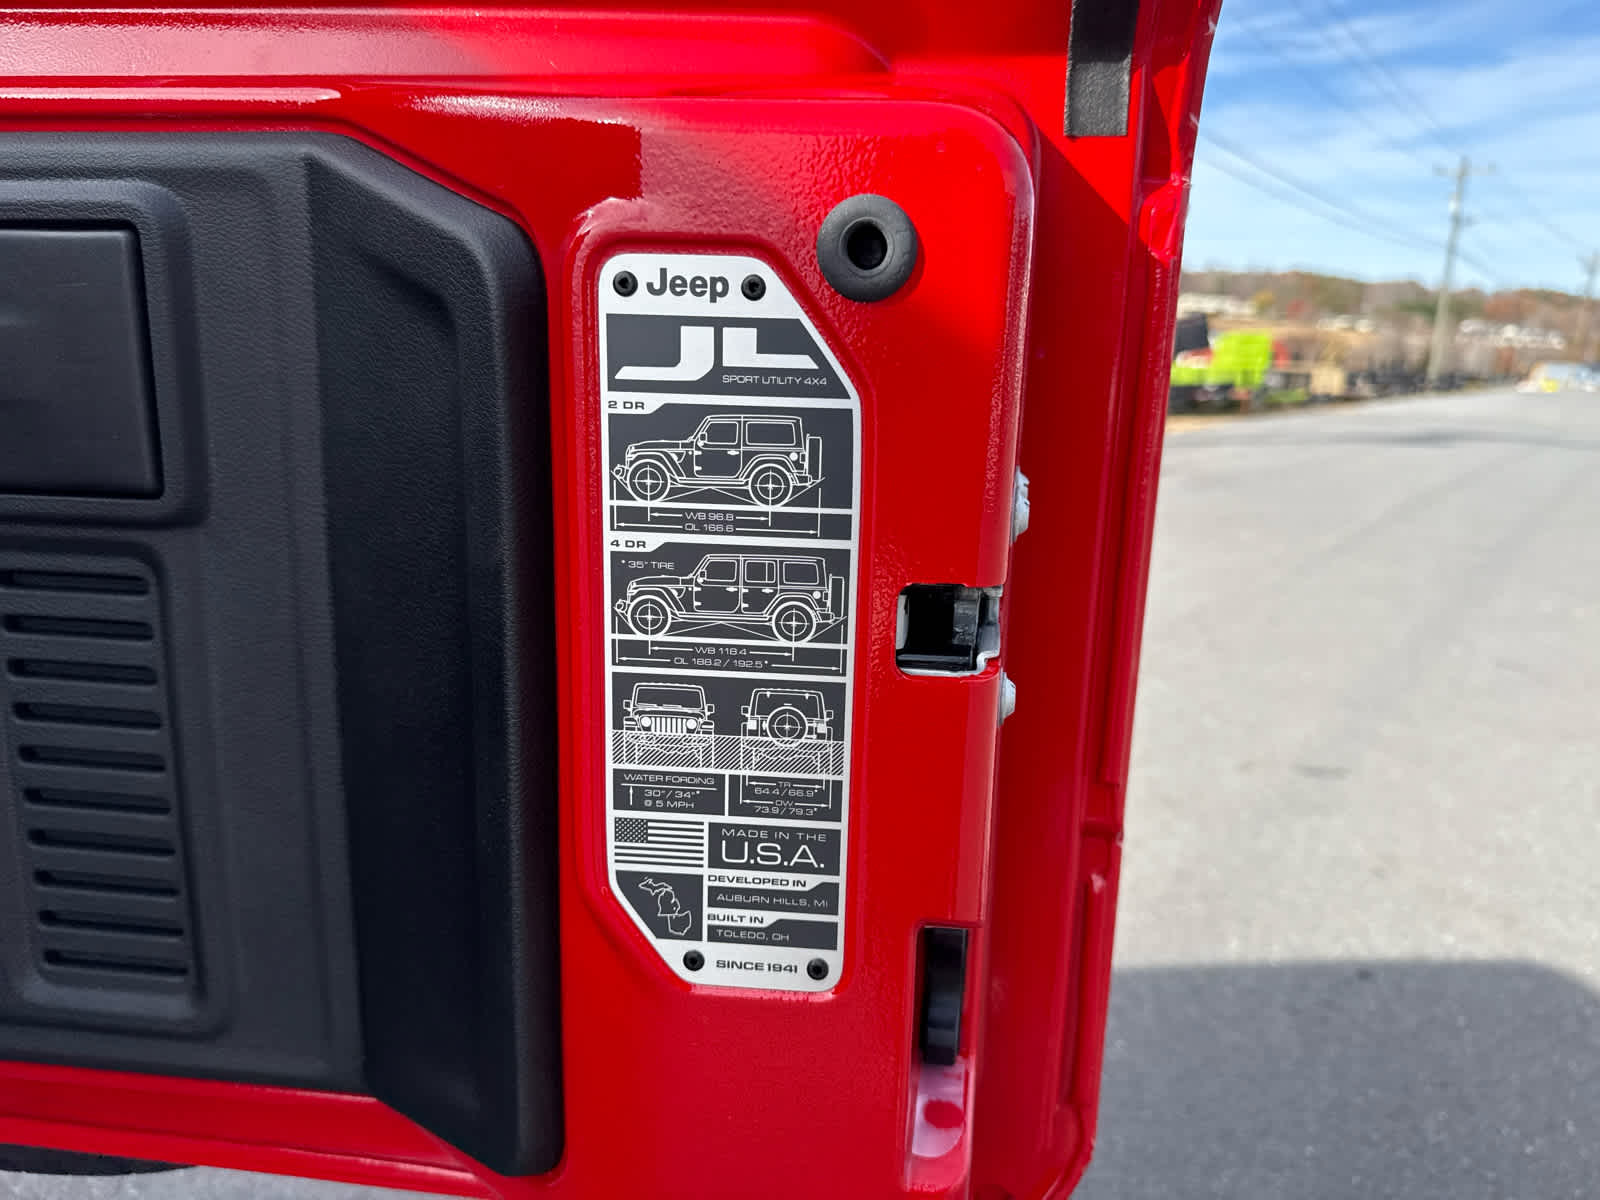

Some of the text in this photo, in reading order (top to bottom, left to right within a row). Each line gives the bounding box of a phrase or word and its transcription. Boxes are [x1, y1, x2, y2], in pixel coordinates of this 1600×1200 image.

[646, 268, 730, 303] Jeep
[614, 325, 820, 382] JL
[722, 374, 760, 384] SPORT
[762, 376, 802, 385] UTILITY
[608, 400, 646, 410] 2 DR
[684, 511, 734, 522] WB 96.8
[703, 523, 734, 532] 166.6
[610, 539, 646, 548] 4 DR
[650, 561, 676, 570] TIRE
[694, 646, 748, 656] WB 118.4
[624, 774, 714, 785] WATER FORDING
[656, 800, 664, 808] 5
[666, 801, 695, 809] MPH
[722, 828, 827, 842] MADE IN THE
[722, 840, 826, 868] U.S.A.
[708, 874, 807, 888] DEVELOPED IN
[716, 893, 829, 908] AUBURN HILLS, MI
[708, 913, 764, 924] BUILT IN
[716, 928, 790, 942] TOLEDO, OH
[716, 958, 798, 974] SINCE 1941
